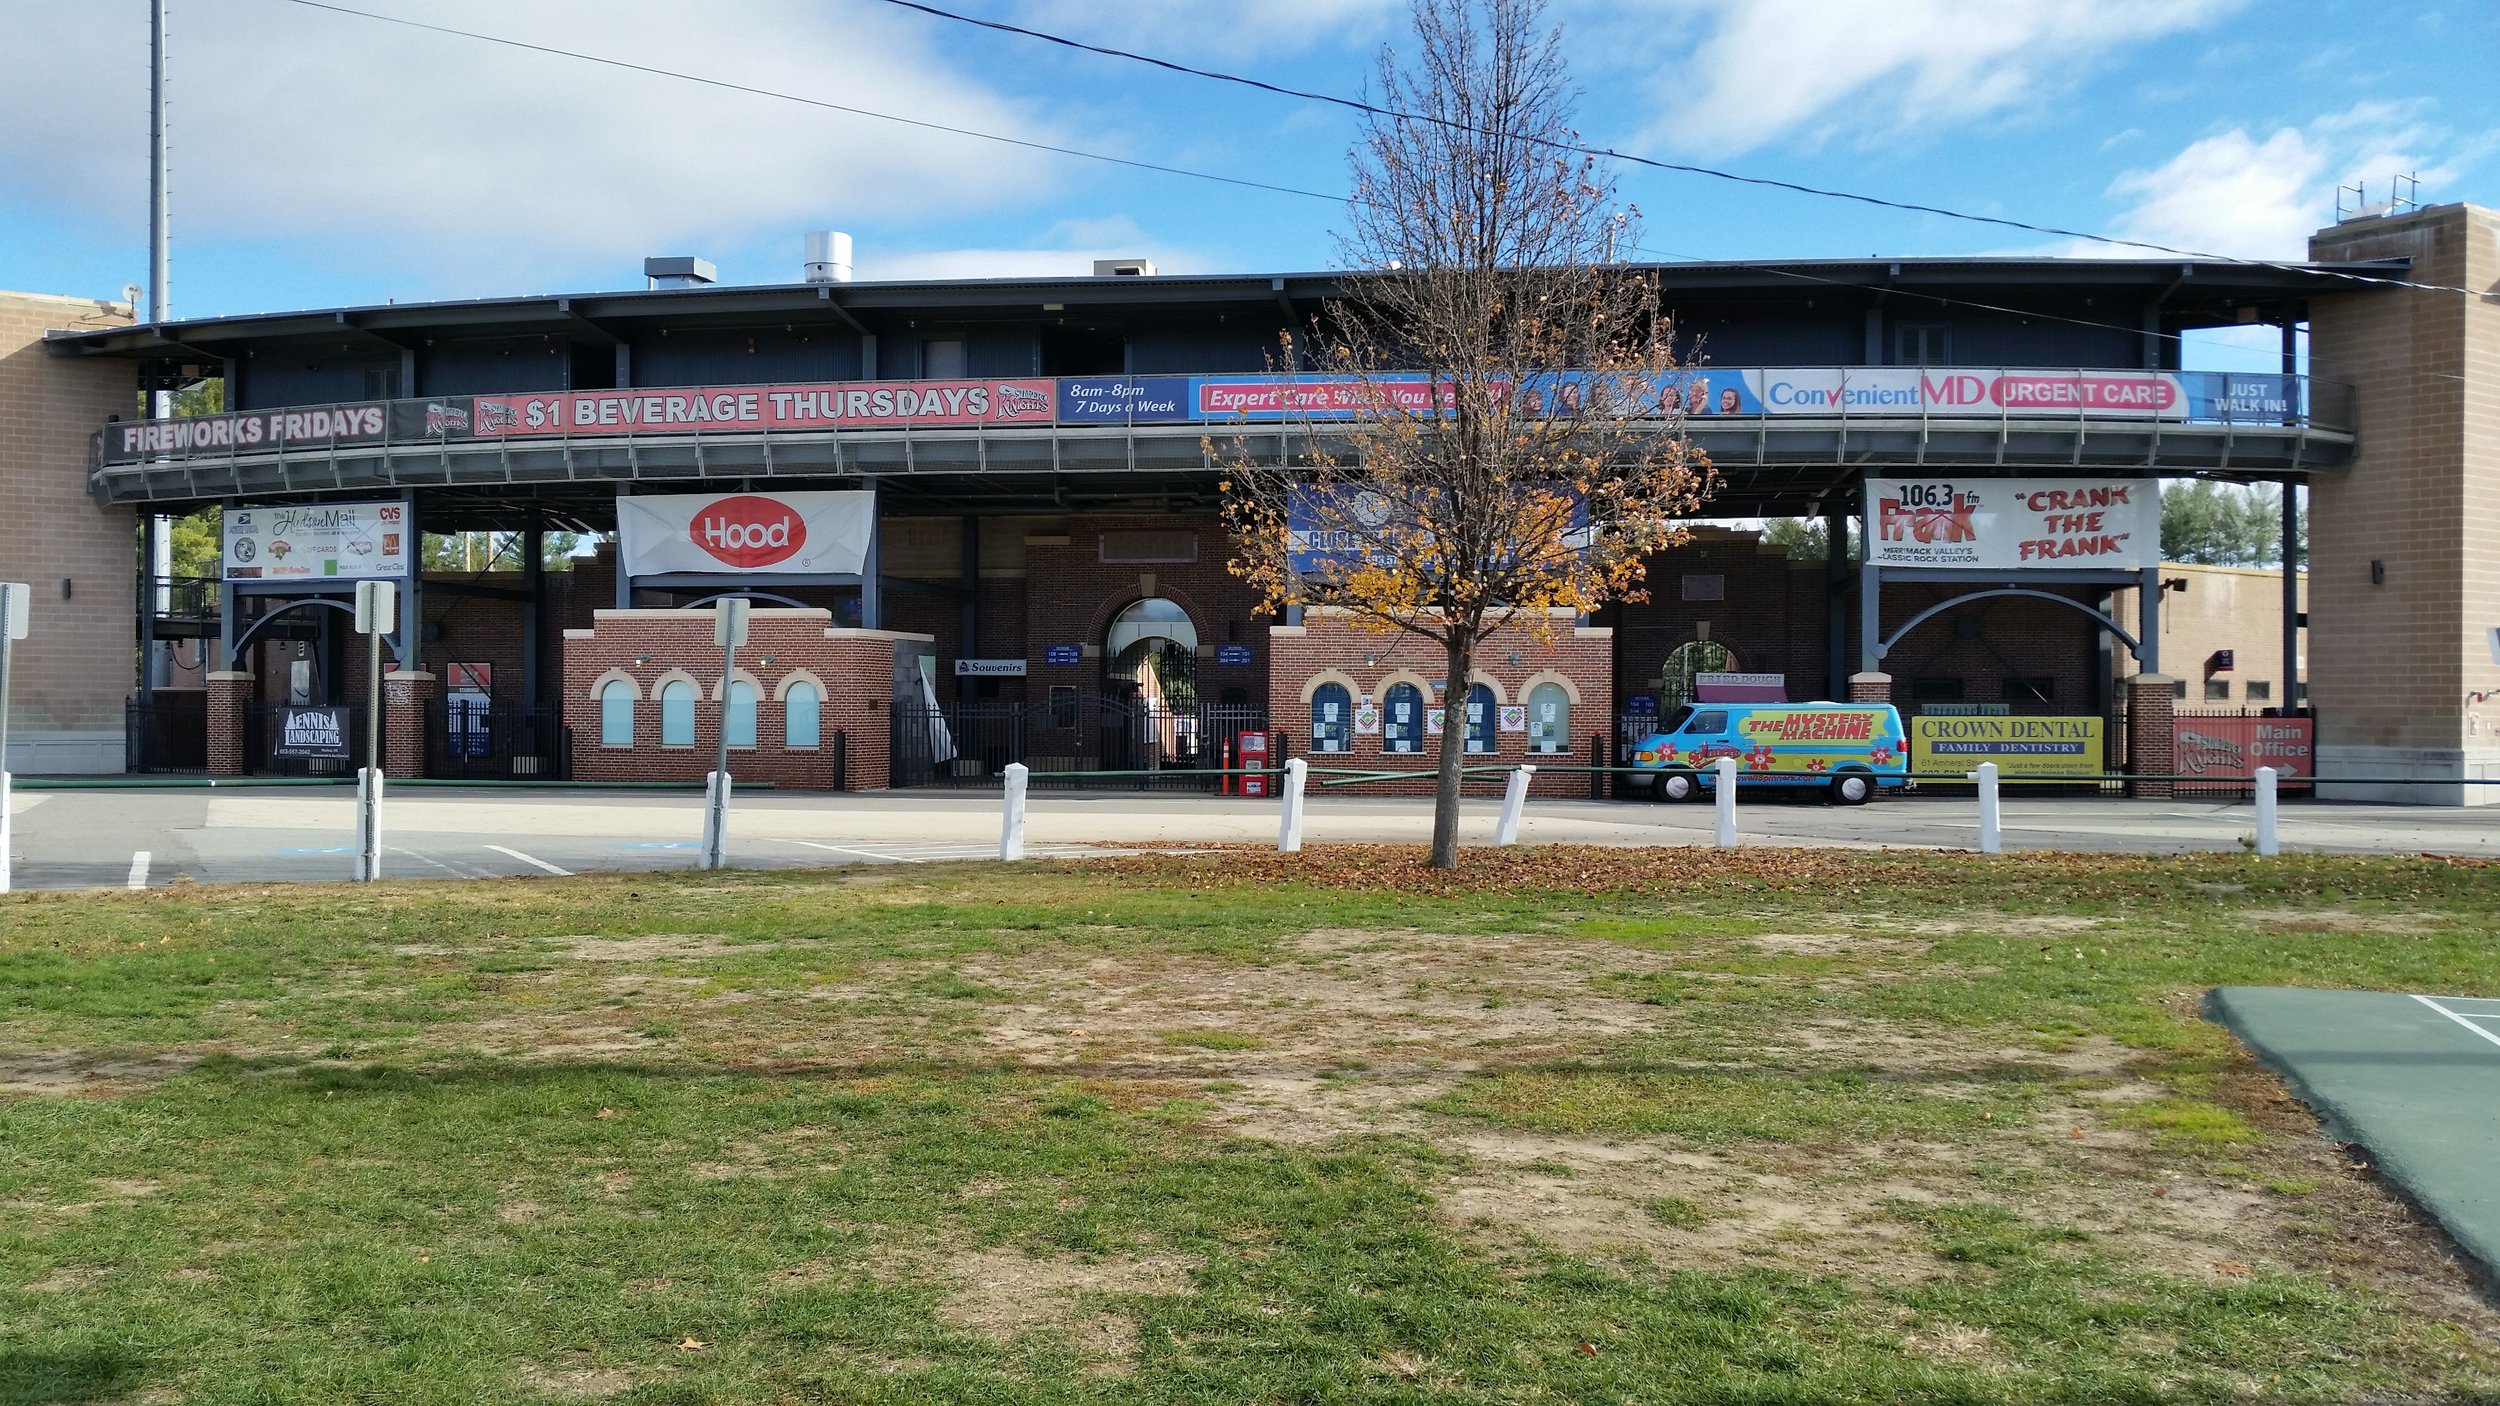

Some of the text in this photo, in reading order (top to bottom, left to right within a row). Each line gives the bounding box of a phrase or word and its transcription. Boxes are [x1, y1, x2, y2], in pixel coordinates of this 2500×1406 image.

[2002, 381, 2097, 403] URGENT
[2103, 383, 2168, 405] CARE
[2230, 383, 2268, 397] JUST
[1075, 400, 1176, 415] 7 Days a Week
[1210, 389, 1278, 410] Expert
[2214, 397, 2288, 412] WALK IN!
[525, 386, 990, 431] $1 BEVERAGE THURSDAYS
[123, 407, 384, 452] FIREWORKS FRIDAYS
[1899, 484, 1980, 507] 106.3 fm
[325, 509, 356, 528] Mall
[379, 507, 401, 521] CVS
[1879, 493, 1977, 544] Frank
[2043, 511, 2107, 534] THE
[704, 515, 790, 549] Hood
[1883, 546, 1973, 555] MERRIMACK VALLEY'S
[1941, 554, 1979, 562] STATION
[376, 563, 391, 571] Great
[971, 662, 1023, 673] Souvenirs
[1699, 674, 1782, 684] FRIED DOUGH
[295, 711, 331, 729] ENNIS
[1748, 713, 1875, 732] THE MYSTERY
[284, 729, 340, 746] LANDSCAPING
[1779, 722, 1873, 740] MACHINE
[1921, 720, 2095, 738] CROWN DENTAL
[2256, 724, 2302, 739] Main
[1938, 743, 2079, 752] FAMILY DENTISTRY
[2250, 742, 2308, 756] Office
[1932, 759, 1965, 767] Amherst
